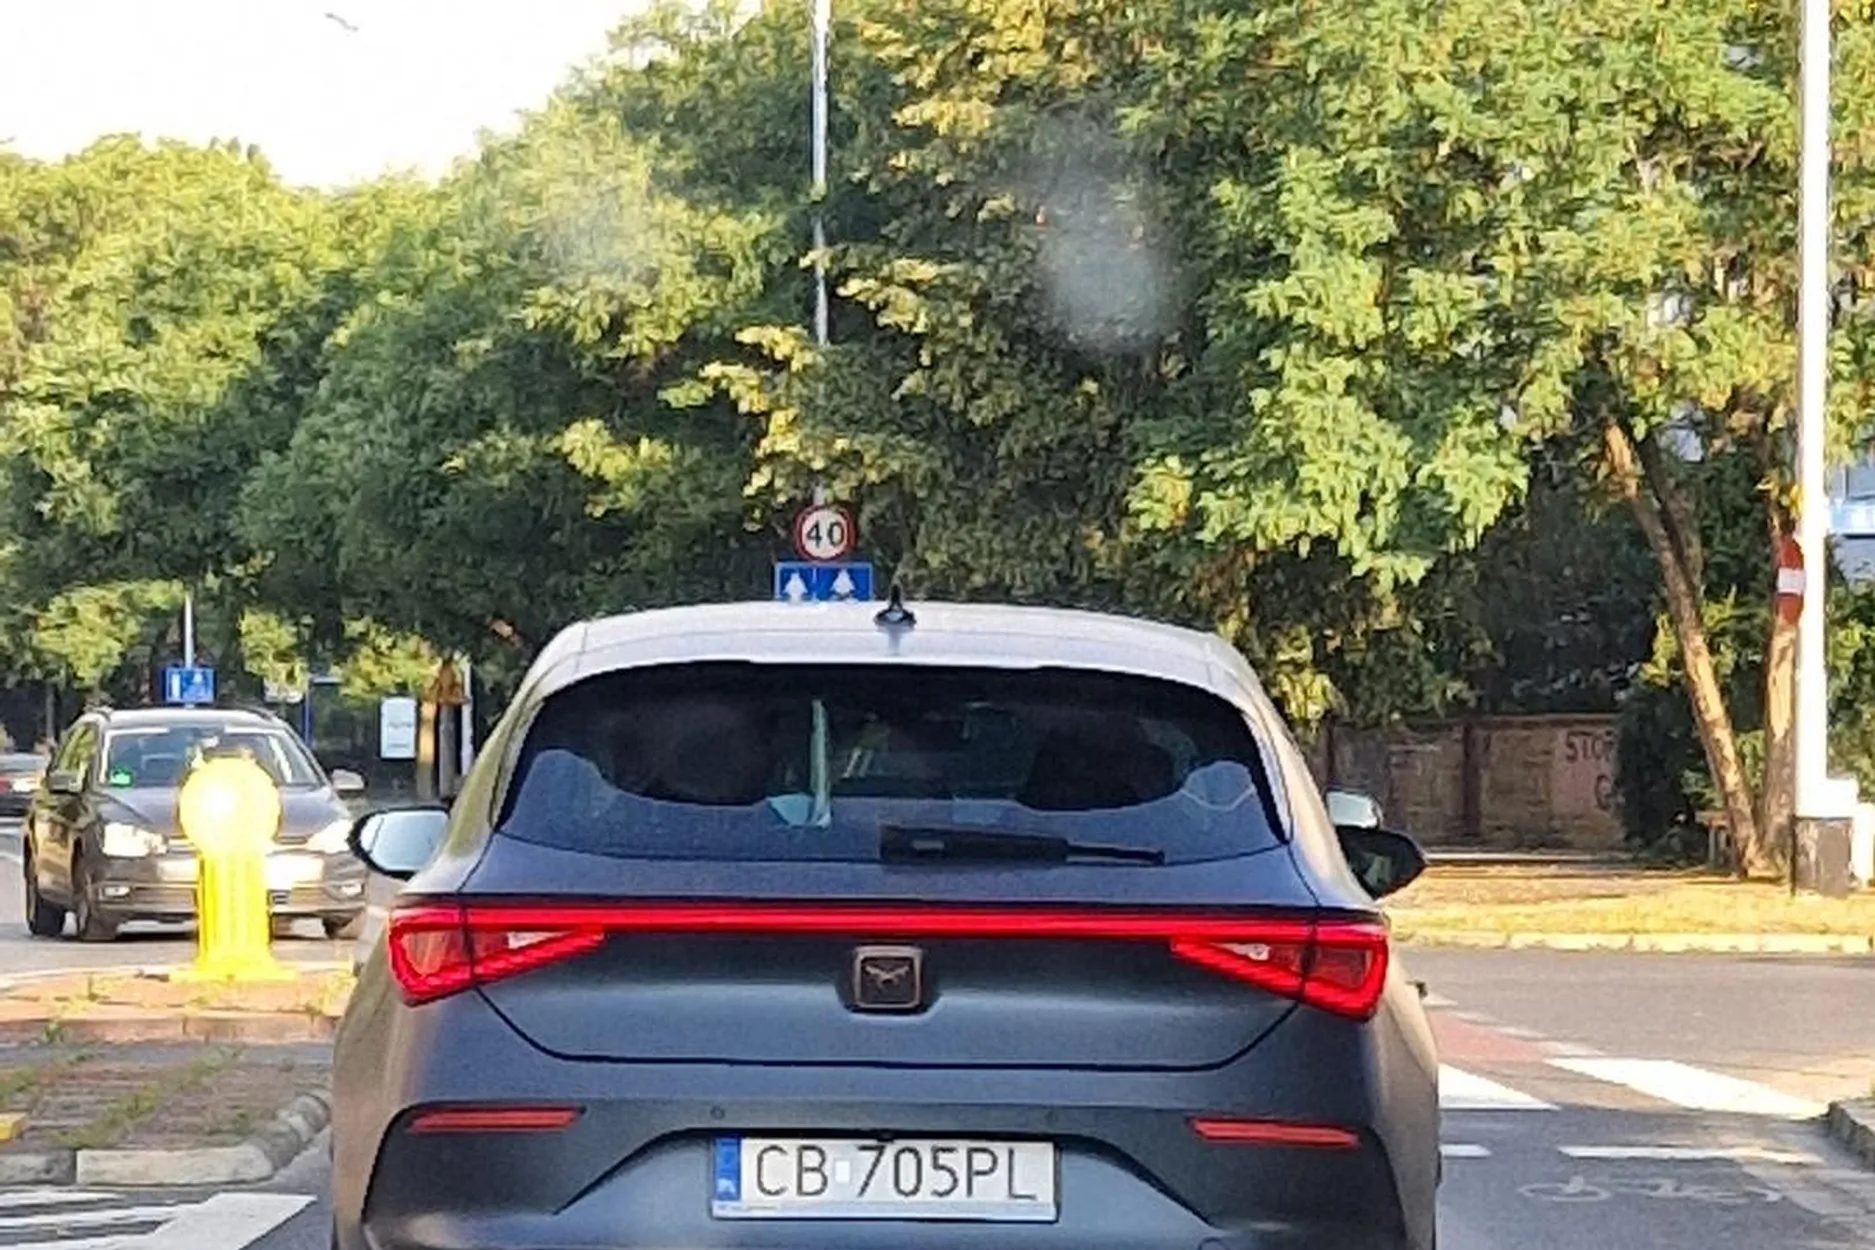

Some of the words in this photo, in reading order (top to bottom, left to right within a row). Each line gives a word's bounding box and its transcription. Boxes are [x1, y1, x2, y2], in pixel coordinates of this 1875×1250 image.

[806, 520, 845, 548] 40
[756, 1145, 828, 1196] CB
[856, 1145, 1038, 1200] 705PL
